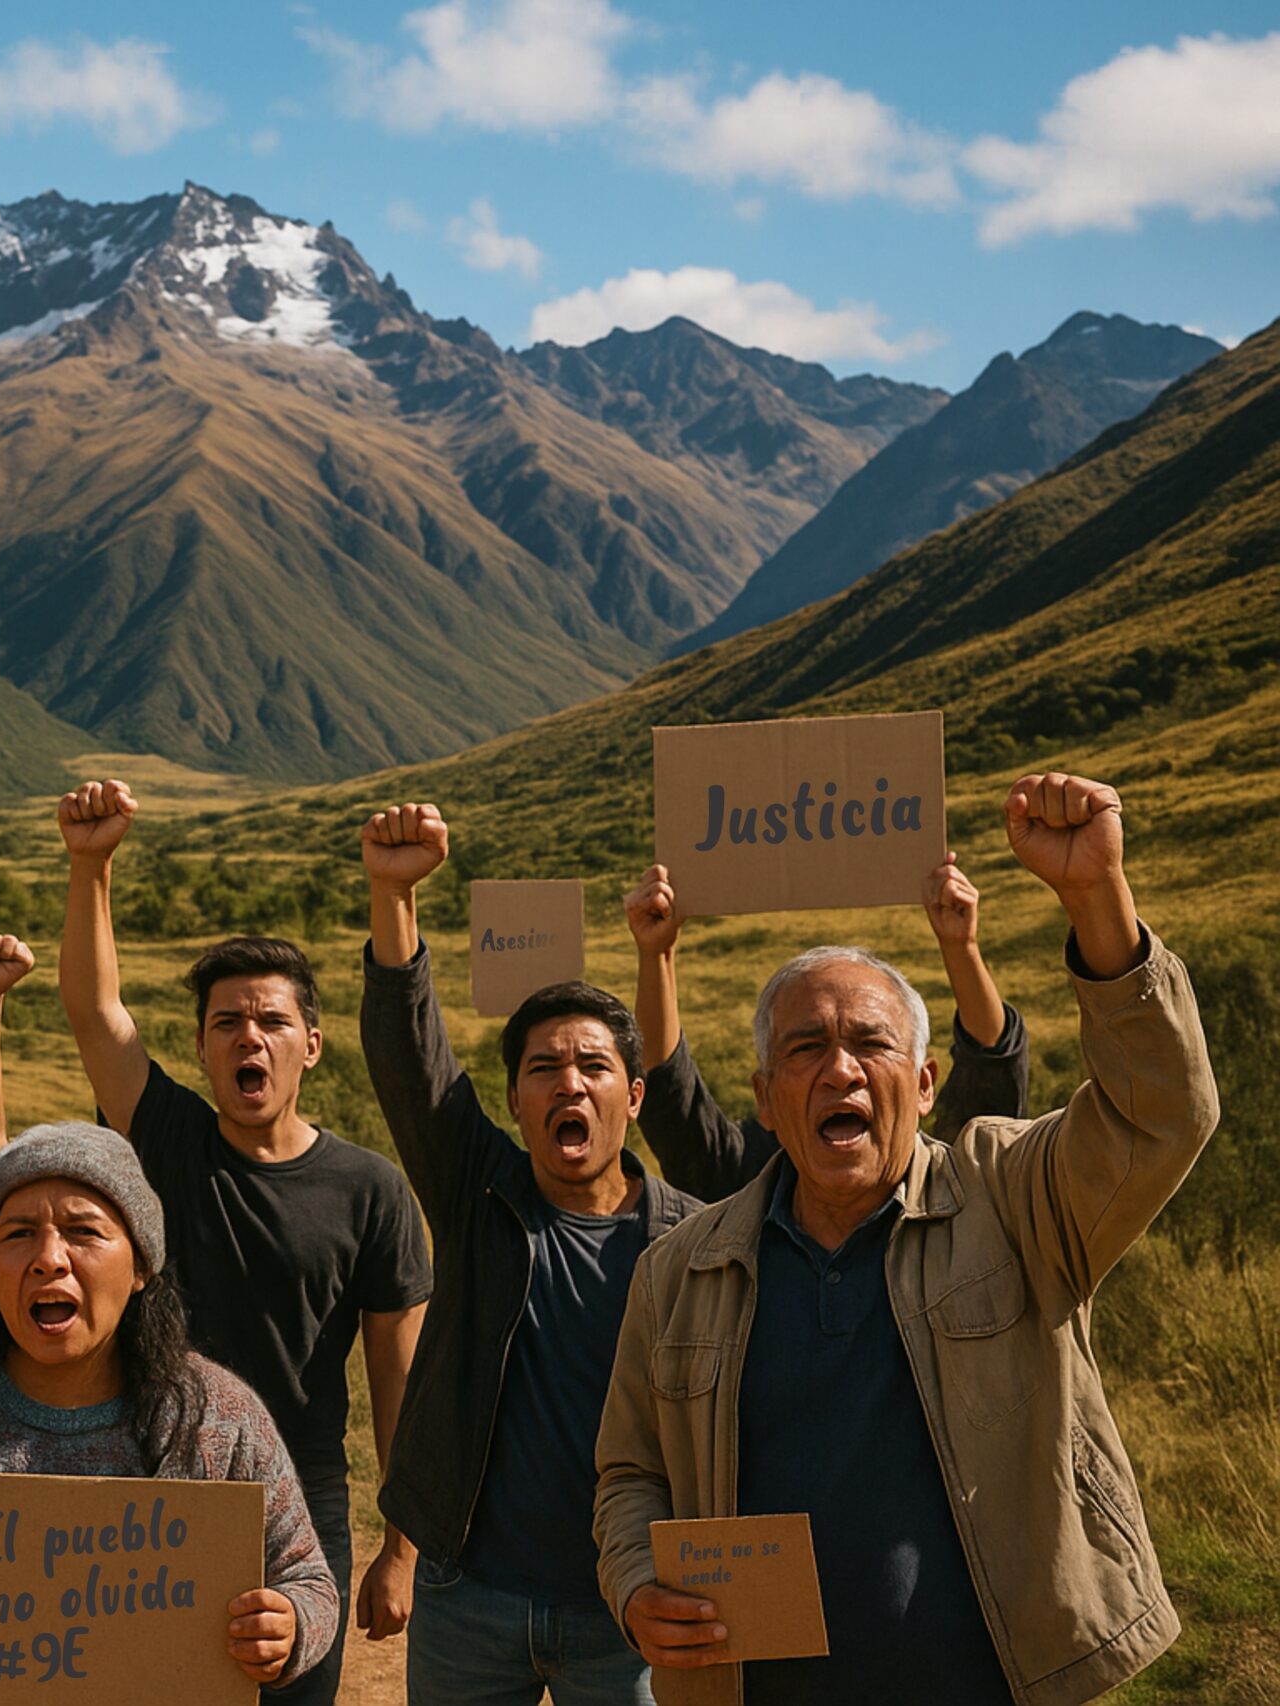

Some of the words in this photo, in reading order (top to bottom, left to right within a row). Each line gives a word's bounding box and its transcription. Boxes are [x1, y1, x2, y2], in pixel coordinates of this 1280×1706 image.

[694, 777, 922, 852] Justicia
[43, 1497, 188, 1579] pueblo
[679, 1540, 722, 1562] Perú
[731, 1543, 753, 1558] no
[761, 1542, 781, 1557] se
[60, 1563, 196, 1619] olvida
[681, 1565, 732, 1587] vende
